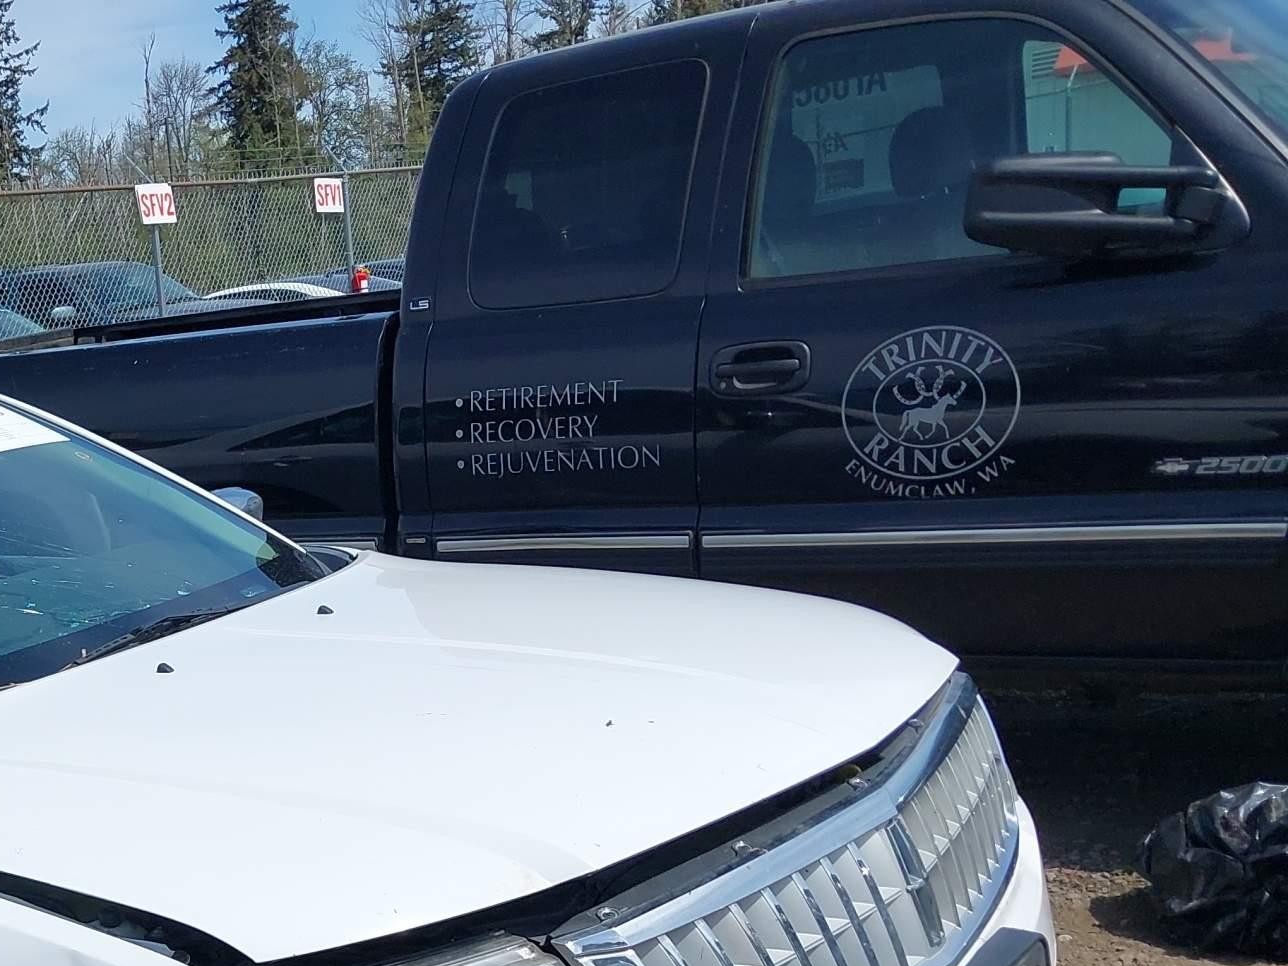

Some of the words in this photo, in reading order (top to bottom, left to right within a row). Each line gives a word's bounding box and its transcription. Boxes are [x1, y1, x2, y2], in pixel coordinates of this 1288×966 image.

[139, 192, 175, 218] SFV2
[316, 183, 343, 208] SFV1
[862, 331, 1002, 381] TRINITY
[470, 380, 623, 411] RETIREMENT
[470, 415, 599, 444] RECOVERY
[472, 445, 660, 477] REJUVENATION
[862, 424, 996, 475] RANCH
[1195, 453, 1288, 474] 2500
[846, 459, 976, 496] ENUMCLAW,
[977, 455, 1016, 483] WA
